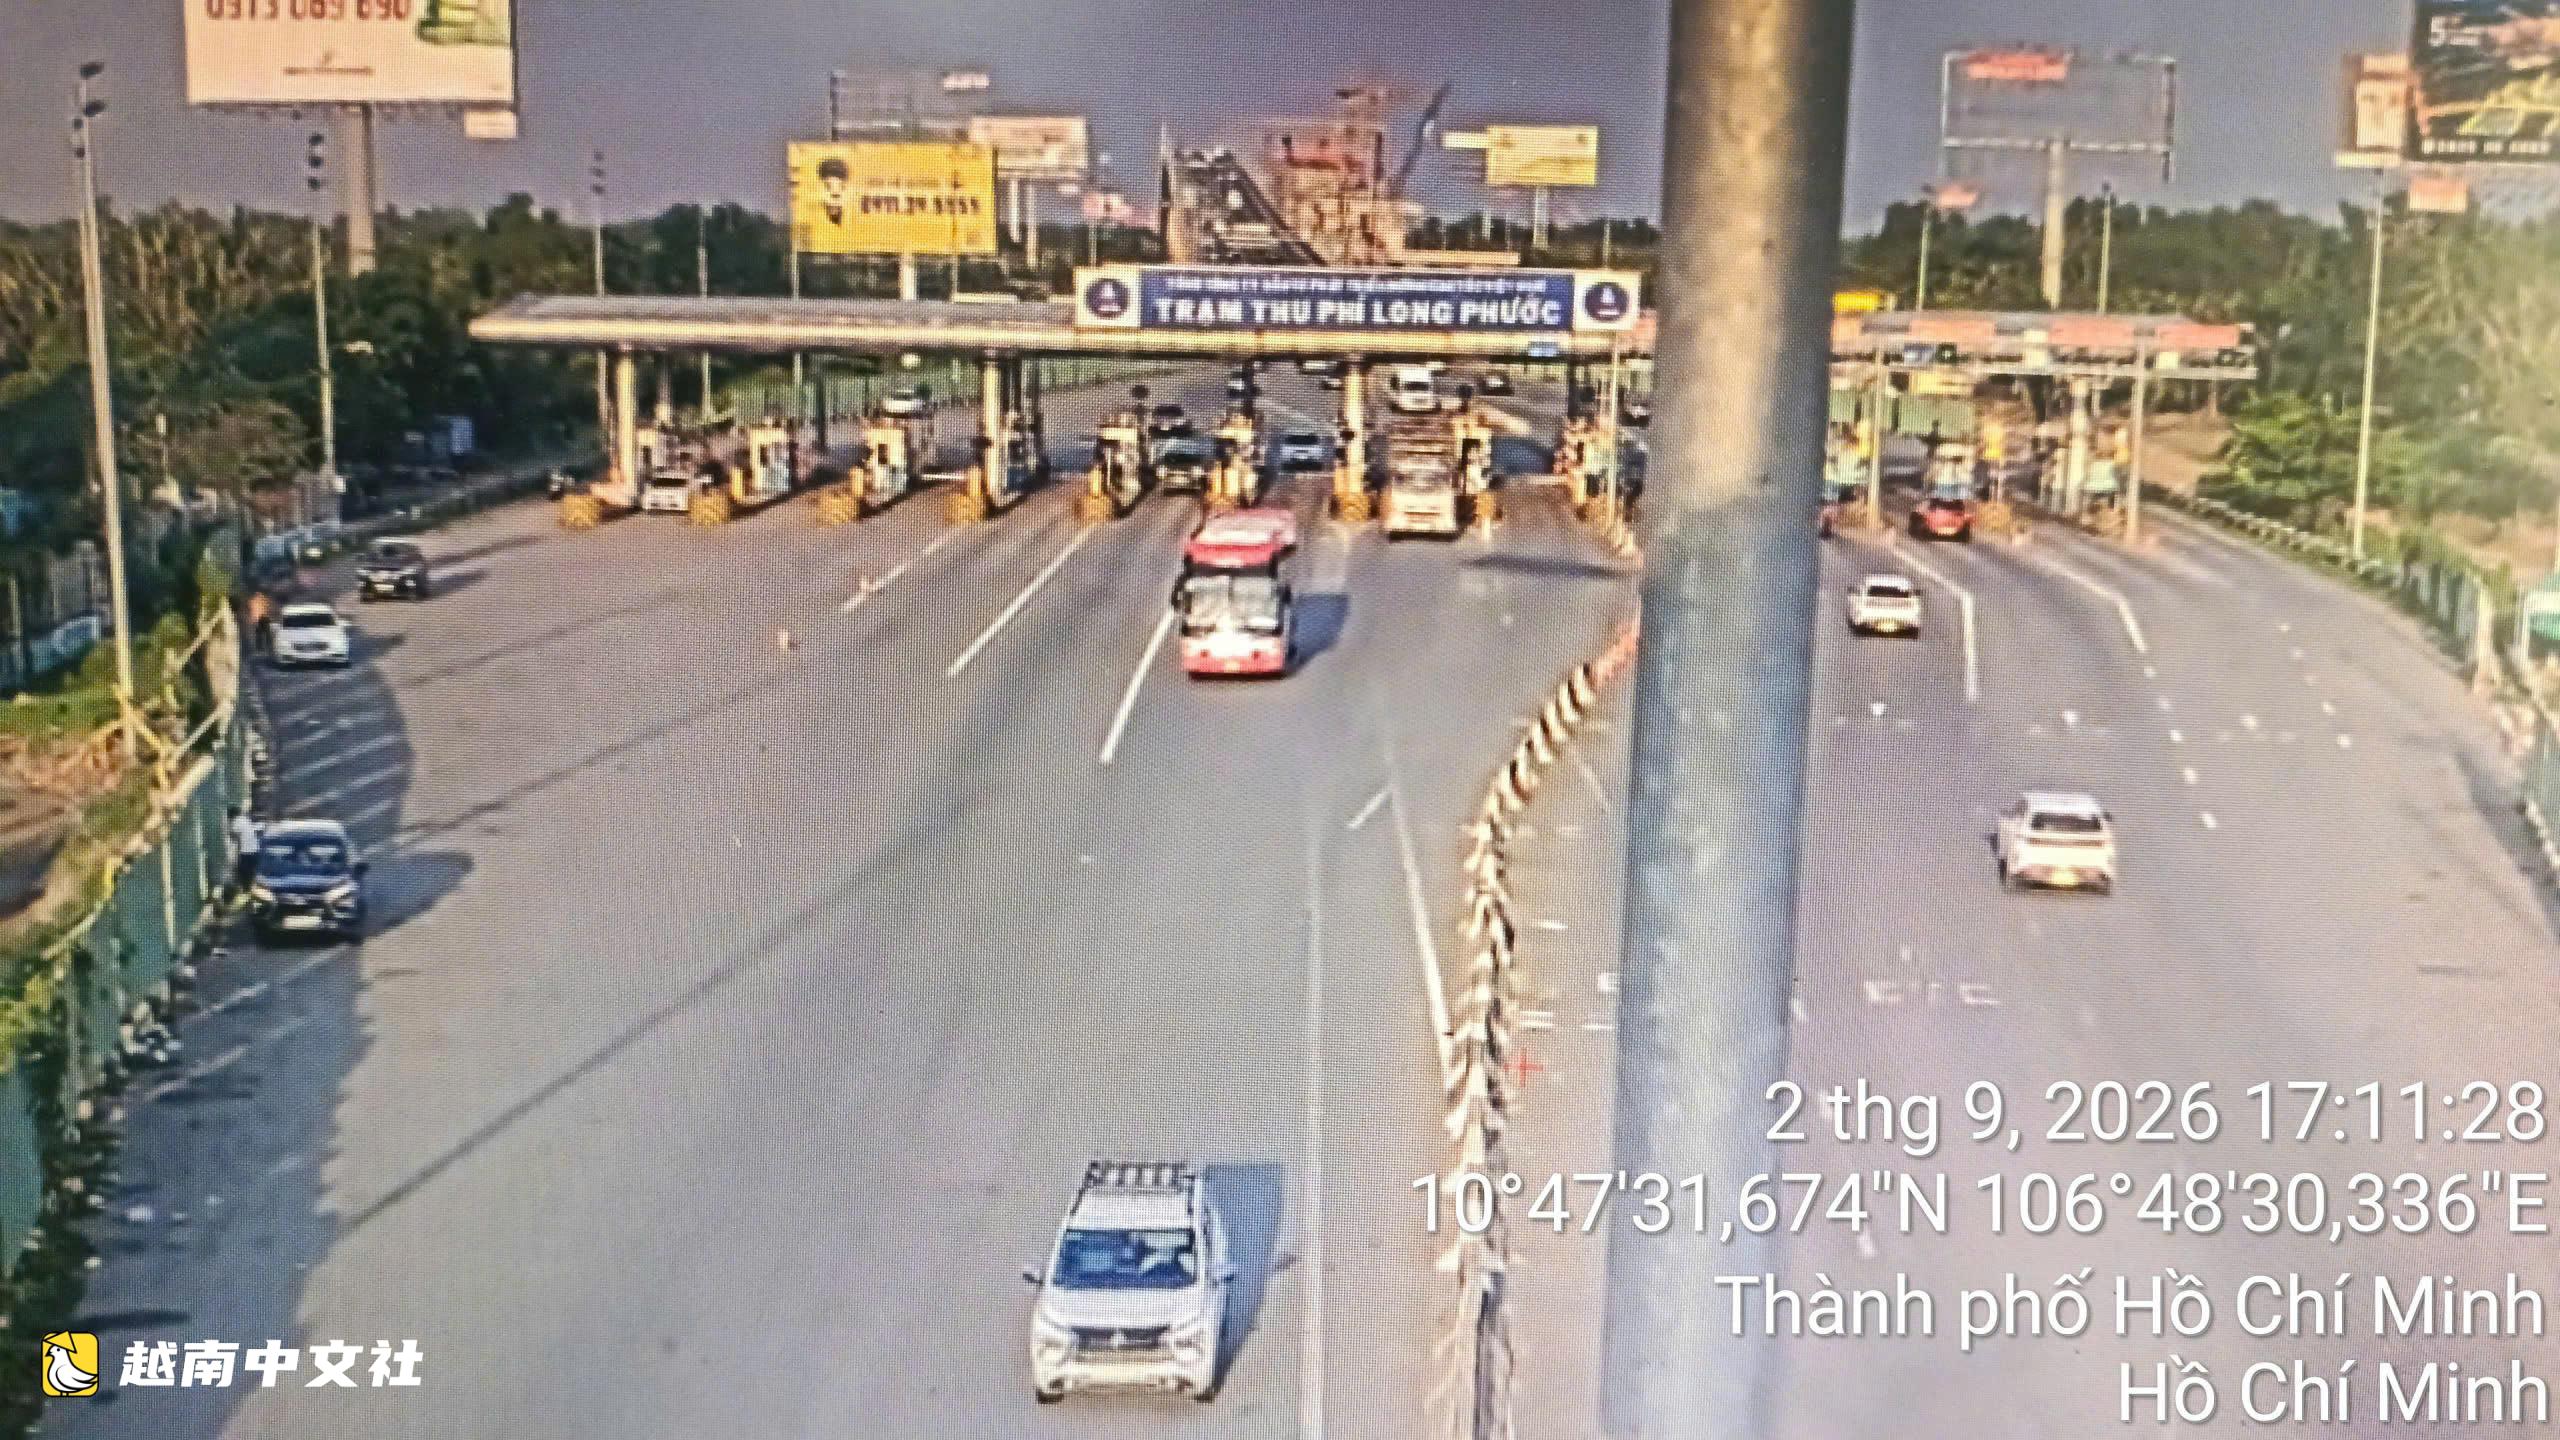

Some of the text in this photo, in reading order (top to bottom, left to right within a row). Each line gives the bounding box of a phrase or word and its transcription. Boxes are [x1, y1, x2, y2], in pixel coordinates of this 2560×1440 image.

[1154, 298, 1243, 326] TRẠM
[1250, 298, 1312, 324] THU
[1372, 299, 1454, 325] LONG
